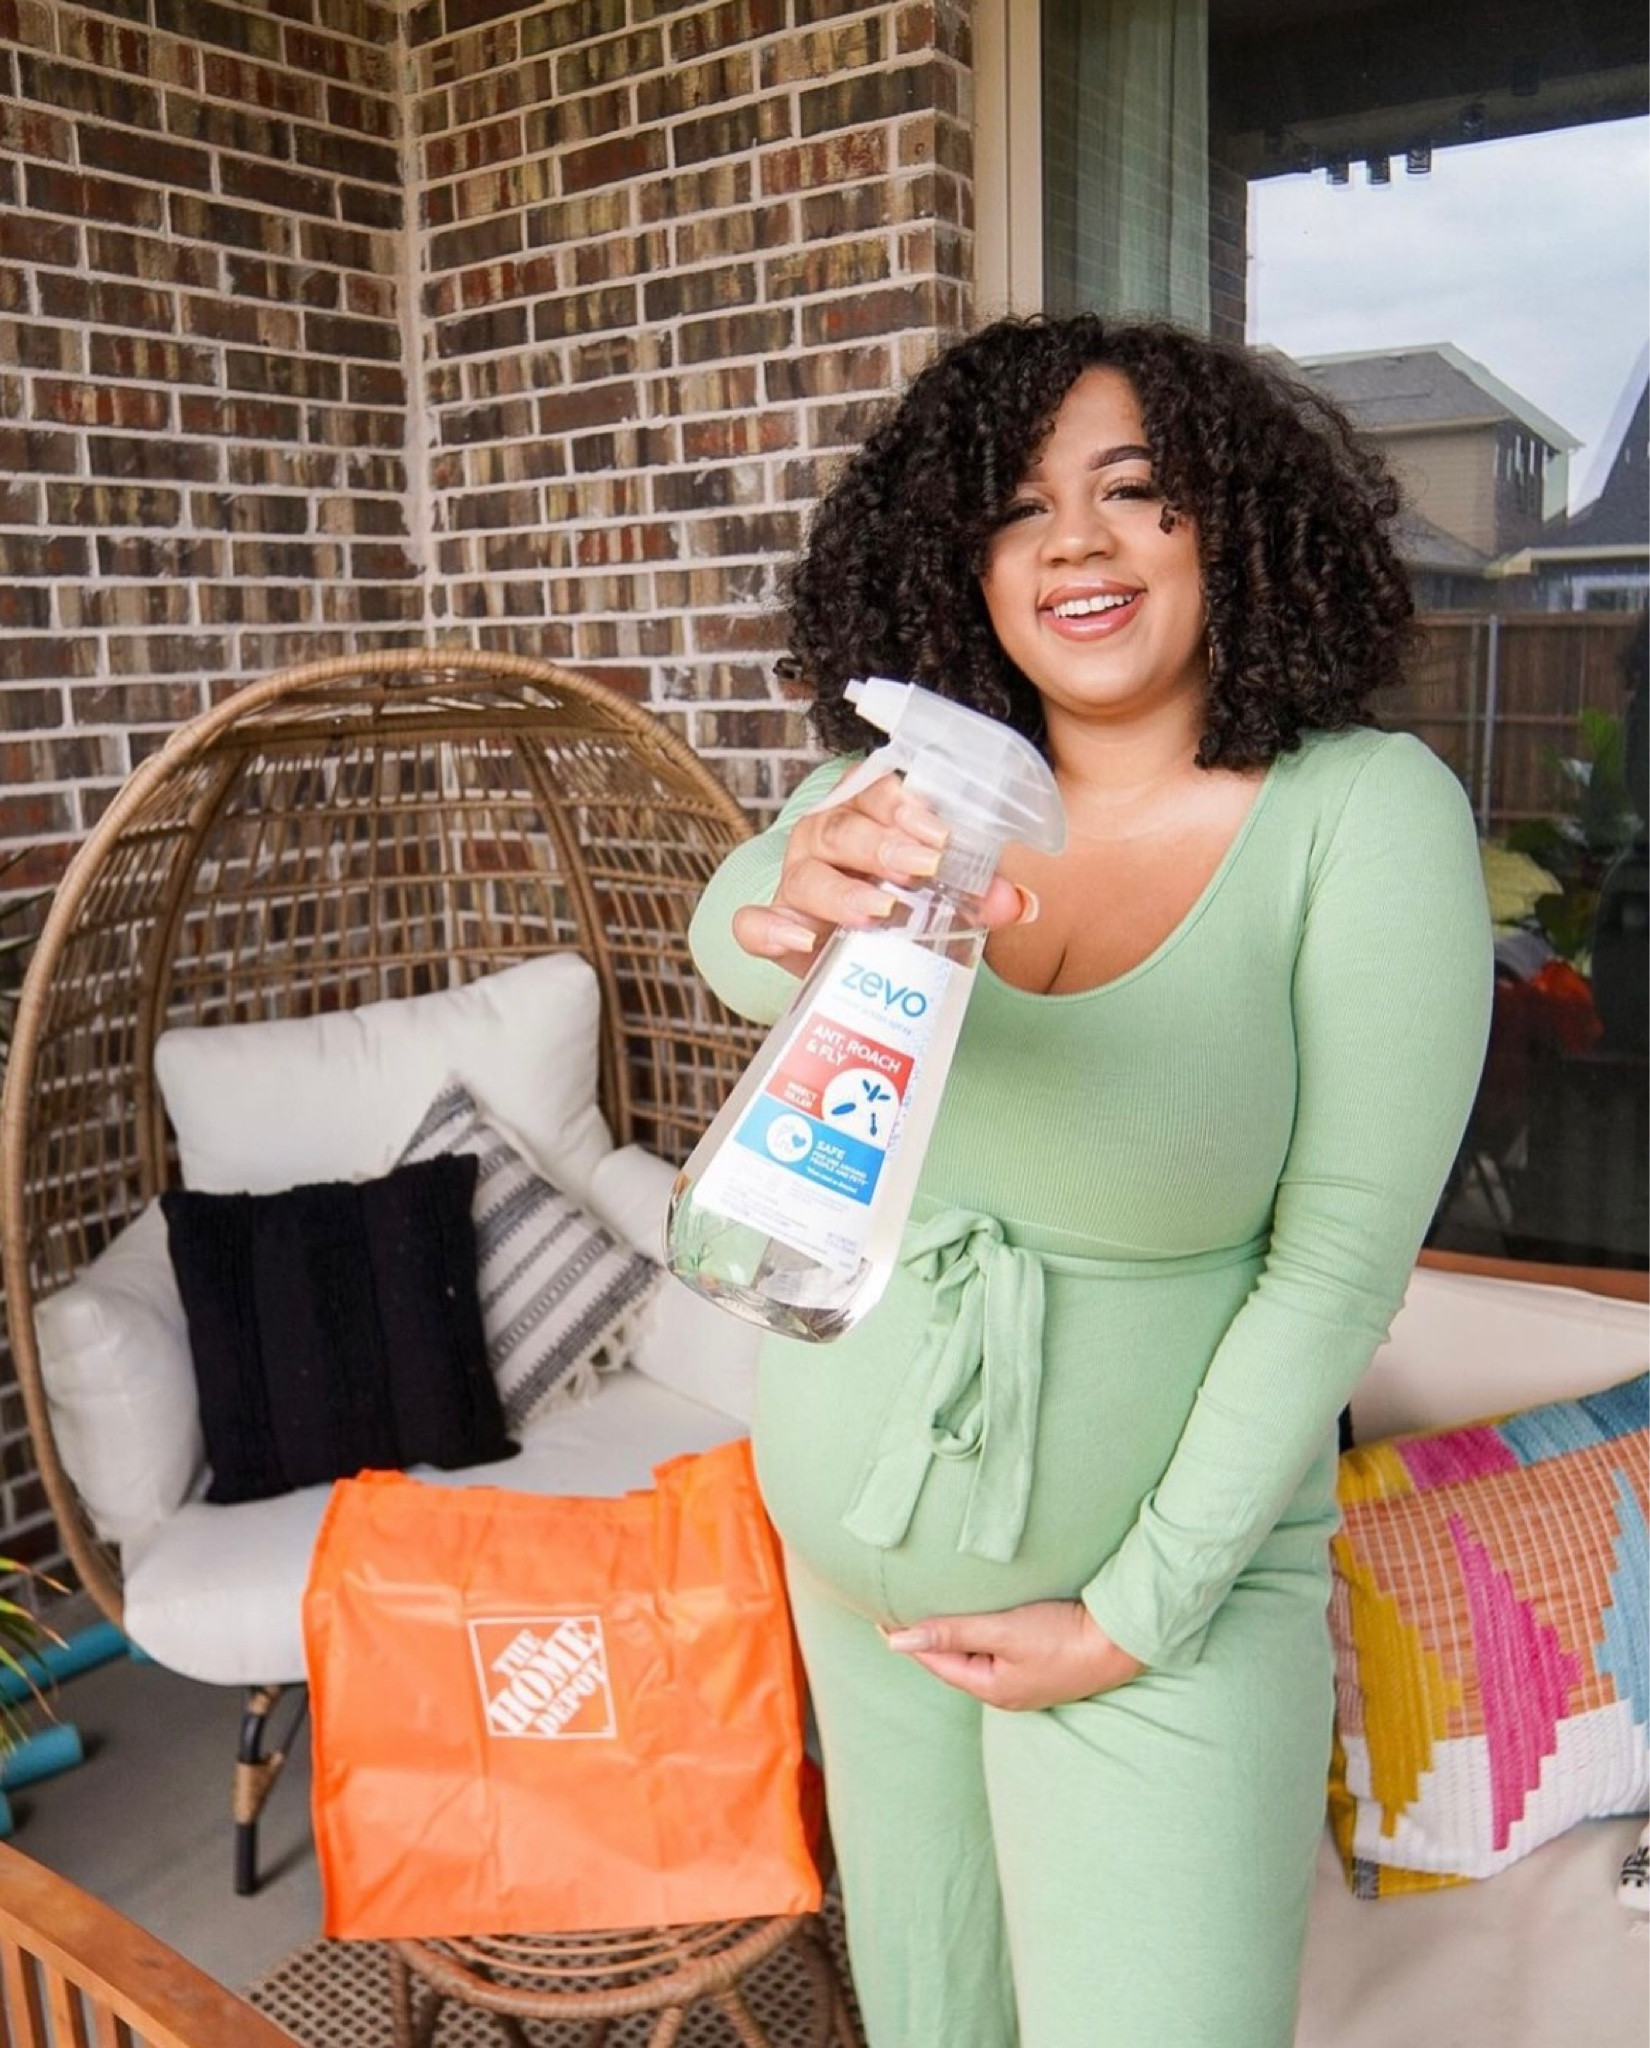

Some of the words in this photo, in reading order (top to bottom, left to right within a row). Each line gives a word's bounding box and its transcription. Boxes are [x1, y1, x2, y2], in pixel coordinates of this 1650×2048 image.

[841, 961, 927, 1018] zevo
[805, 1038, 818, 1054] &
[819, 1042, 847, 1066] FLY
[813, 1024, 845, 1051] ANT,
[846, 1041, 902, 1073] ROACH
[816, 1140, 846, 1161] SAFE
[491, 1628, 544, 1677] THE
[488, 1619, 602, 1736] HOME
[534, 1657, 607, 1737] DEPOT
